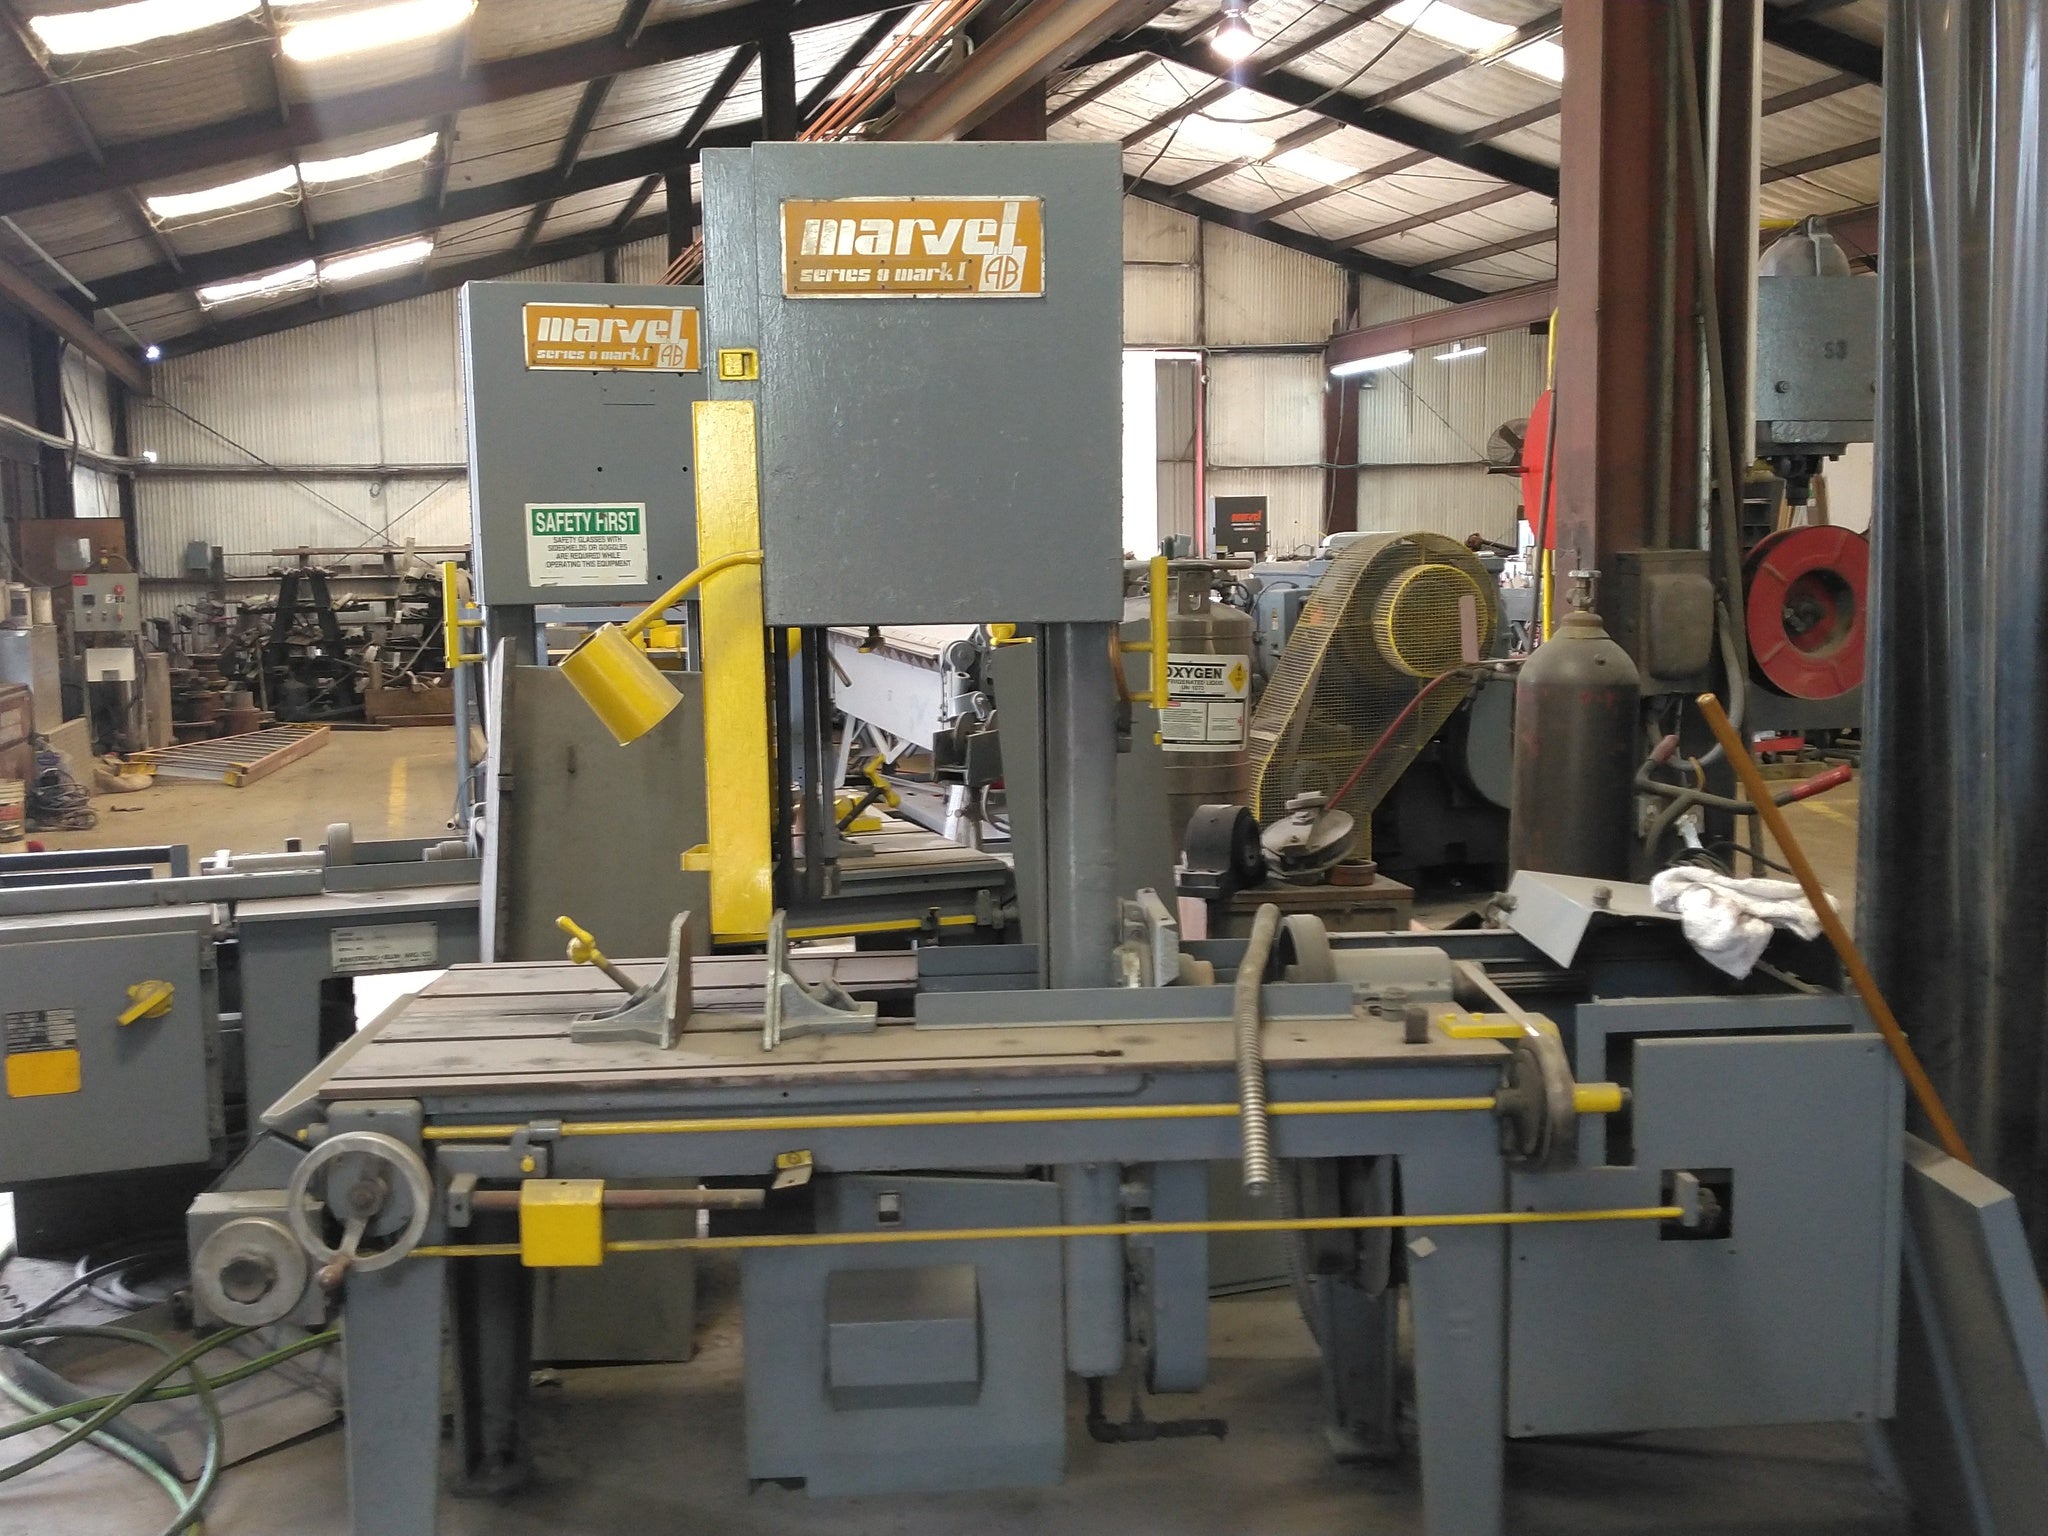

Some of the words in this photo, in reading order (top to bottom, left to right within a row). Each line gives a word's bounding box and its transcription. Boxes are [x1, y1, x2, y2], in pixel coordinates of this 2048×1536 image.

[800, 201, 1020, 256] marvel
[800, 267, 871, 282] series
[894, 261, 953, 282] mark
[537, 309, 684, 344] marvel
[536, 349, 585, 360] series
[601, 348, 640, 361] mark
[535, 511, 592, 532] SAFETY
[595, 511, 637, 532] FIRST
[598, 543, 628, 551] GOGGLES
[546, 560, 582, 568] OPERATING
[597, 560, 631, 568] EQUIPMENT
